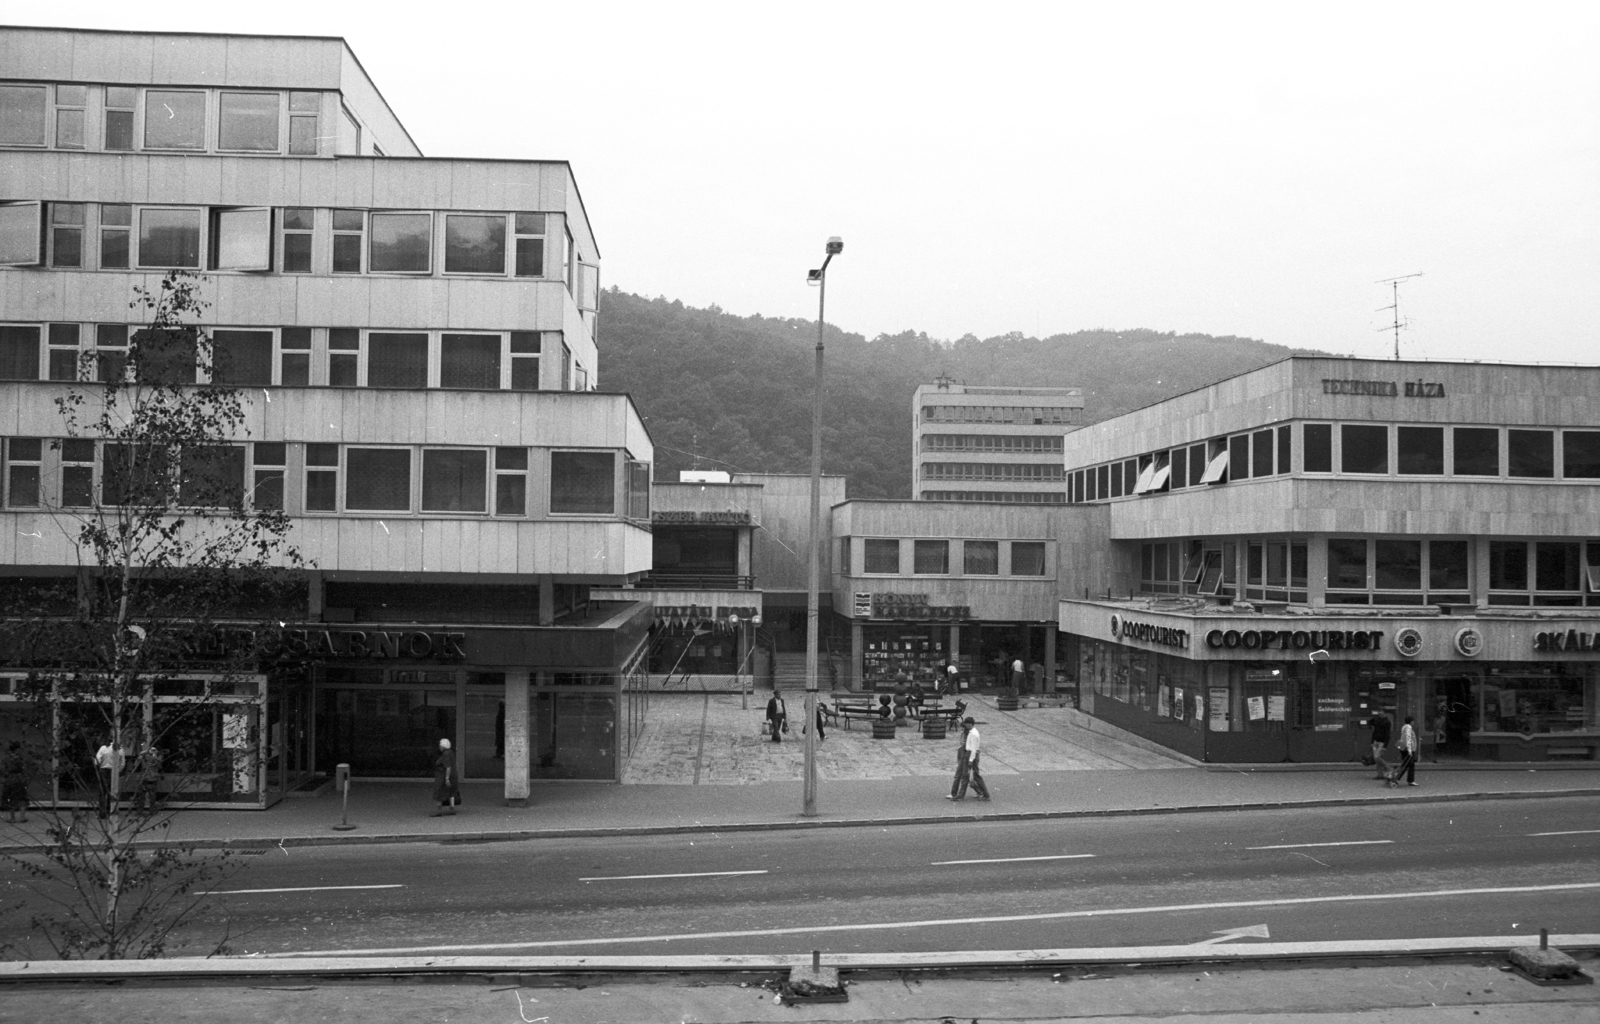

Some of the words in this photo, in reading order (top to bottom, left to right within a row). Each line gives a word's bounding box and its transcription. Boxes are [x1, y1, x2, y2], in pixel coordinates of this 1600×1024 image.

[1404, 378, 1445, 398] HÁZA
[873, 592, 930, 604] KÖNYV
[1123, 620, 1186, 649] COOPTOURIST
[1205, 629, 1384, 650] COOPTOURIST
